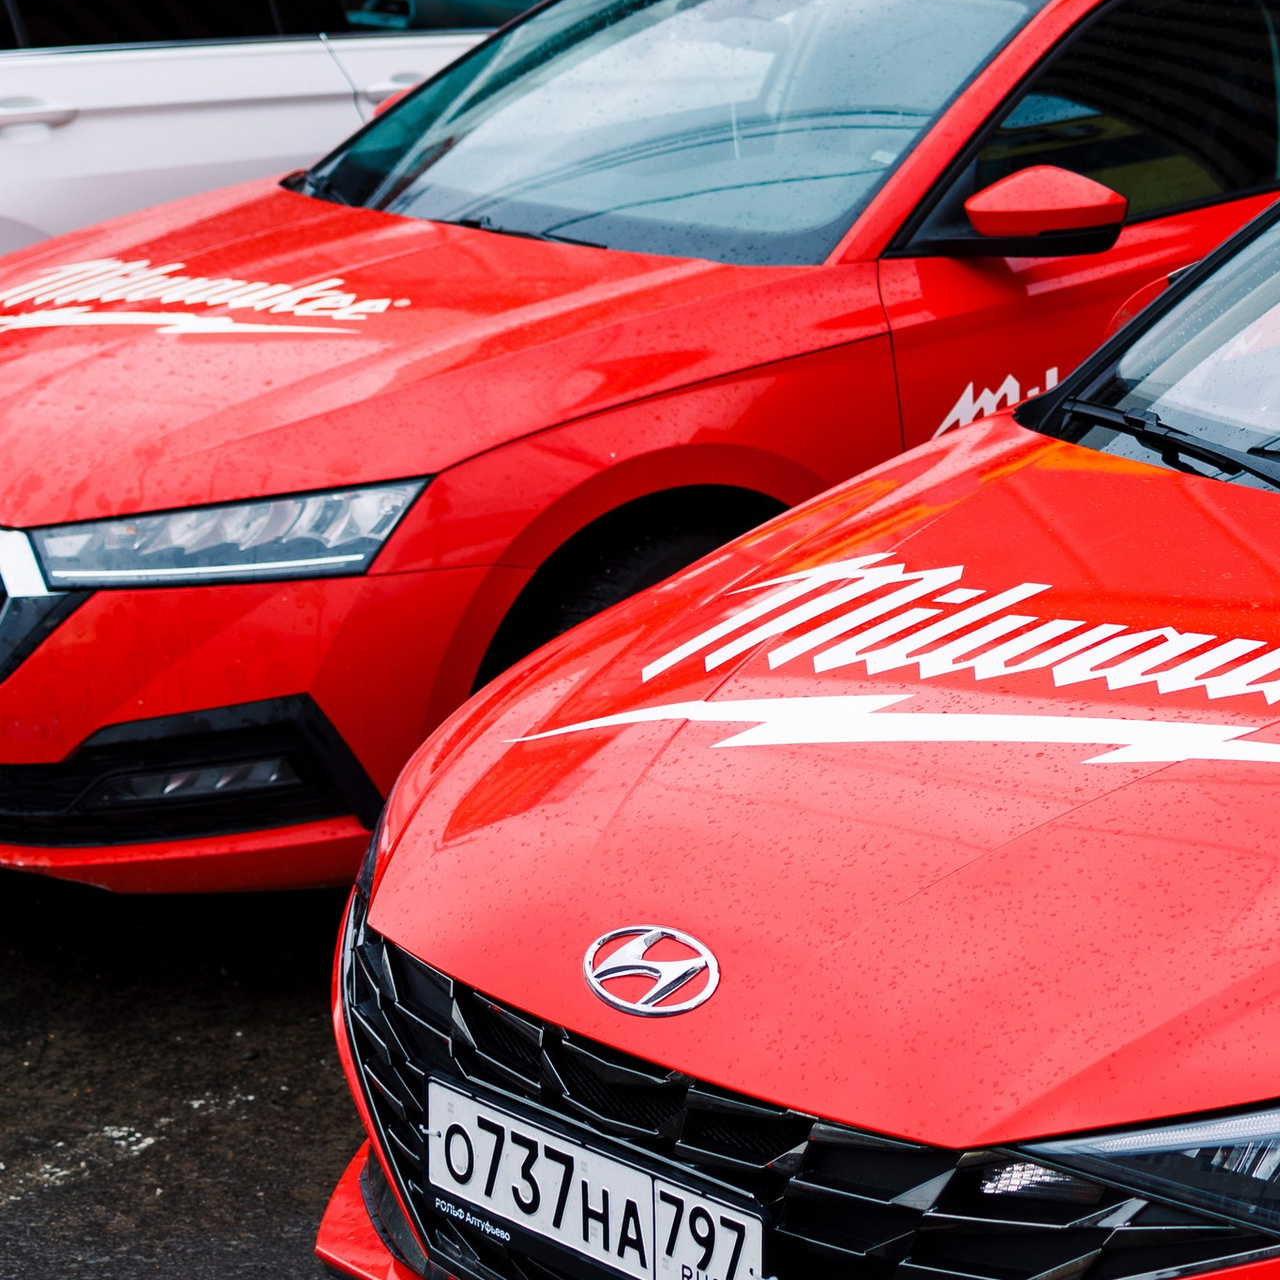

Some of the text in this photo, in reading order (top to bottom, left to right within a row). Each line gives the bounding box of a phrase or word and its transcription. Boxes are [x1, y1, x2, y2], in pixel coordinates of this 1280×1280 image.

[435, 1197, 511, 1242] РОЛЬФ Алтуфьево
[659, 1189, 746, 1280] 797
